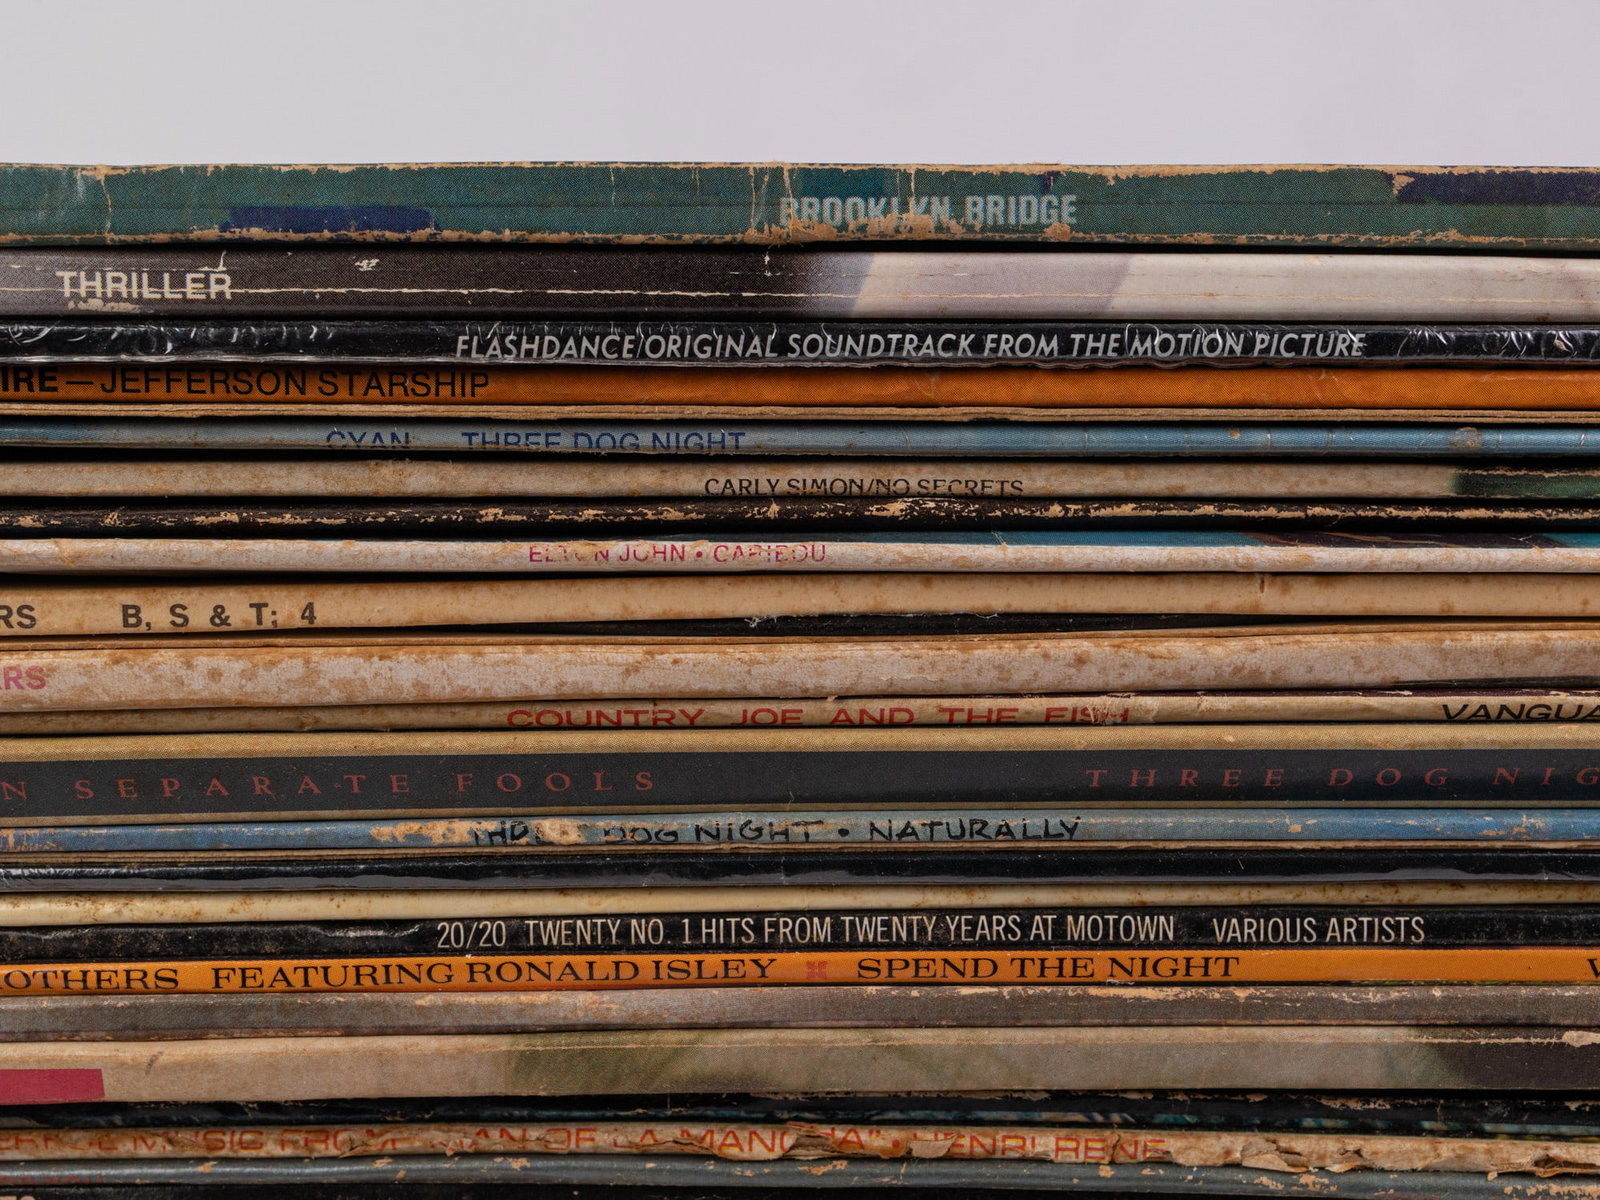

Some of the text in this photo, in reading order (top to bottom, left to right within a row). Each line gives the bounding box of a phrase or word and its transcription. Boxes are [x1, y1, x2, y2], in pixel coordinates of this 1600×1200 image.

[965, 194, 1077, 224] BRIDGE
[56, 270, 233, 300] THRILLER
[787, 332, 973, 360] SOUNDTRACK
[982, 333, 1059, 358] FROM
[1070, 334, 1119, 358] THE
[1126, 333, 1245, 358] MOTION
[1253, 332, 1367, 359] PICTURE
[318, 370, 490, 399] STARSHIP
[461, 431, 746, 450] THREE DOG NIGHT
[704, 478, 780, 497] CARLY
[917, 479, 1024, 497] SECRETS
[619, 543, 686, 563] JOHN
[121, 603, 153, 631] B,
[169, 603, 190, 629] S
[209, 604, 233, 628] &
[300, 601, 318, 625] 4
[0, 665, 47, 691] RS
[506, 708, 706, 727] COUNTRY
[729, 707, 804, 727] JOE
[829, 706, 915, 725] AND
[938, 706, 1019, 725] THE
[73, 774, 410, 800] SEPARATE
[456, 769, 655, 793] FOOLS
[1087, 768, 1286, 789] THREE
[1328, 766, 1449, 788] DOG
[603, 824, 679, 845] DOG
[869, 815, 1081, 842] NATURALLY
[436, 914, 1175, 949] 20/20 TWENTY NO. 1 HITS FROM TWENTY YEARS AT MOTOWN
[1213, 917, 1425, 944] VARIOUS ARTISTS
[0, 958, 777, 990] OTHERS FEATURING RONALD ISLEY
[857, 956, 1240, 980] SPEND THE NIGHT
[913, 1132, 1036, 1156] ENRI
